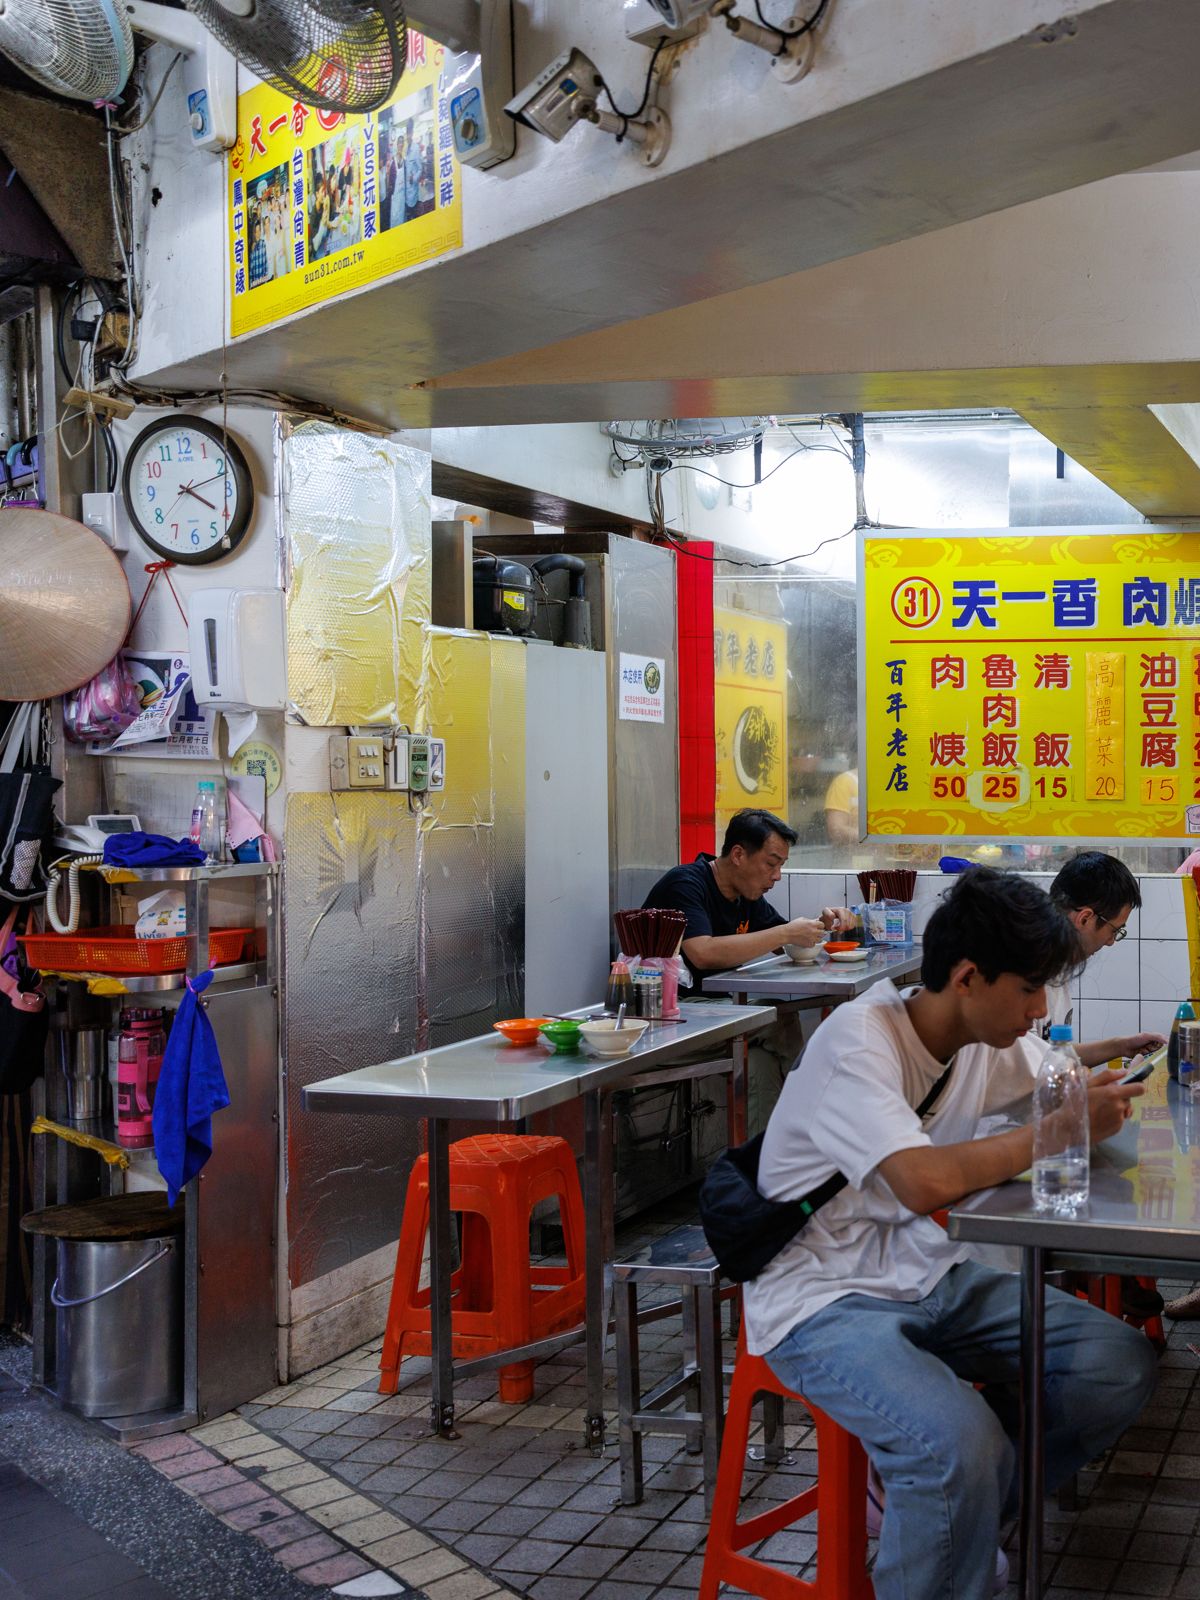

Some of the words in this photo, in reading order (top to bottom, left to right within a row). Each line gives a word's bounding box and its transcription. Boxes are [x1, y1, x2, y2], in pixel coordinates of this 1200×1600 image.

[249, 101, 310, 160] 天一香
[304, 249, 365, 284] aun31.com.tw
[159, 445, 172, 461] 11
[176, 437, 192, 455] 12
[201, 443, 208, 459] 1
[146, 461, 162, 478] 10
[216, 458, 228, 475] 2
[147, 485, 156, 502] 9
[155, 508, 164, 524] 8
[222, 504, 230, 521] 4
[171, 523, 179, 540] 7
[191, 528, 200, 545] 6
[210, 521, 218, 538] 5
[904, 587, 929, 617] 31
[952, 578, 1098, 628] 天一香
[982, 653, 1018, 767] 魯肉飯
[1033, 652, 1071, 767] 清飯
[1094, 658, 1115, 767] 高麗菜
[1140, 651, 1178, 768] 油豆腐
[175, 722, 206, 733] 星期一
[885, 658, 909, 793] 百年老店
[933, 776, 966, 799] 50
[984, 777, 1018, 799] 25
[1035, 776, 1068, 799] 15
[1095, 776, 1116, 797] 20
[1146, 778, 1175, 801] 15
